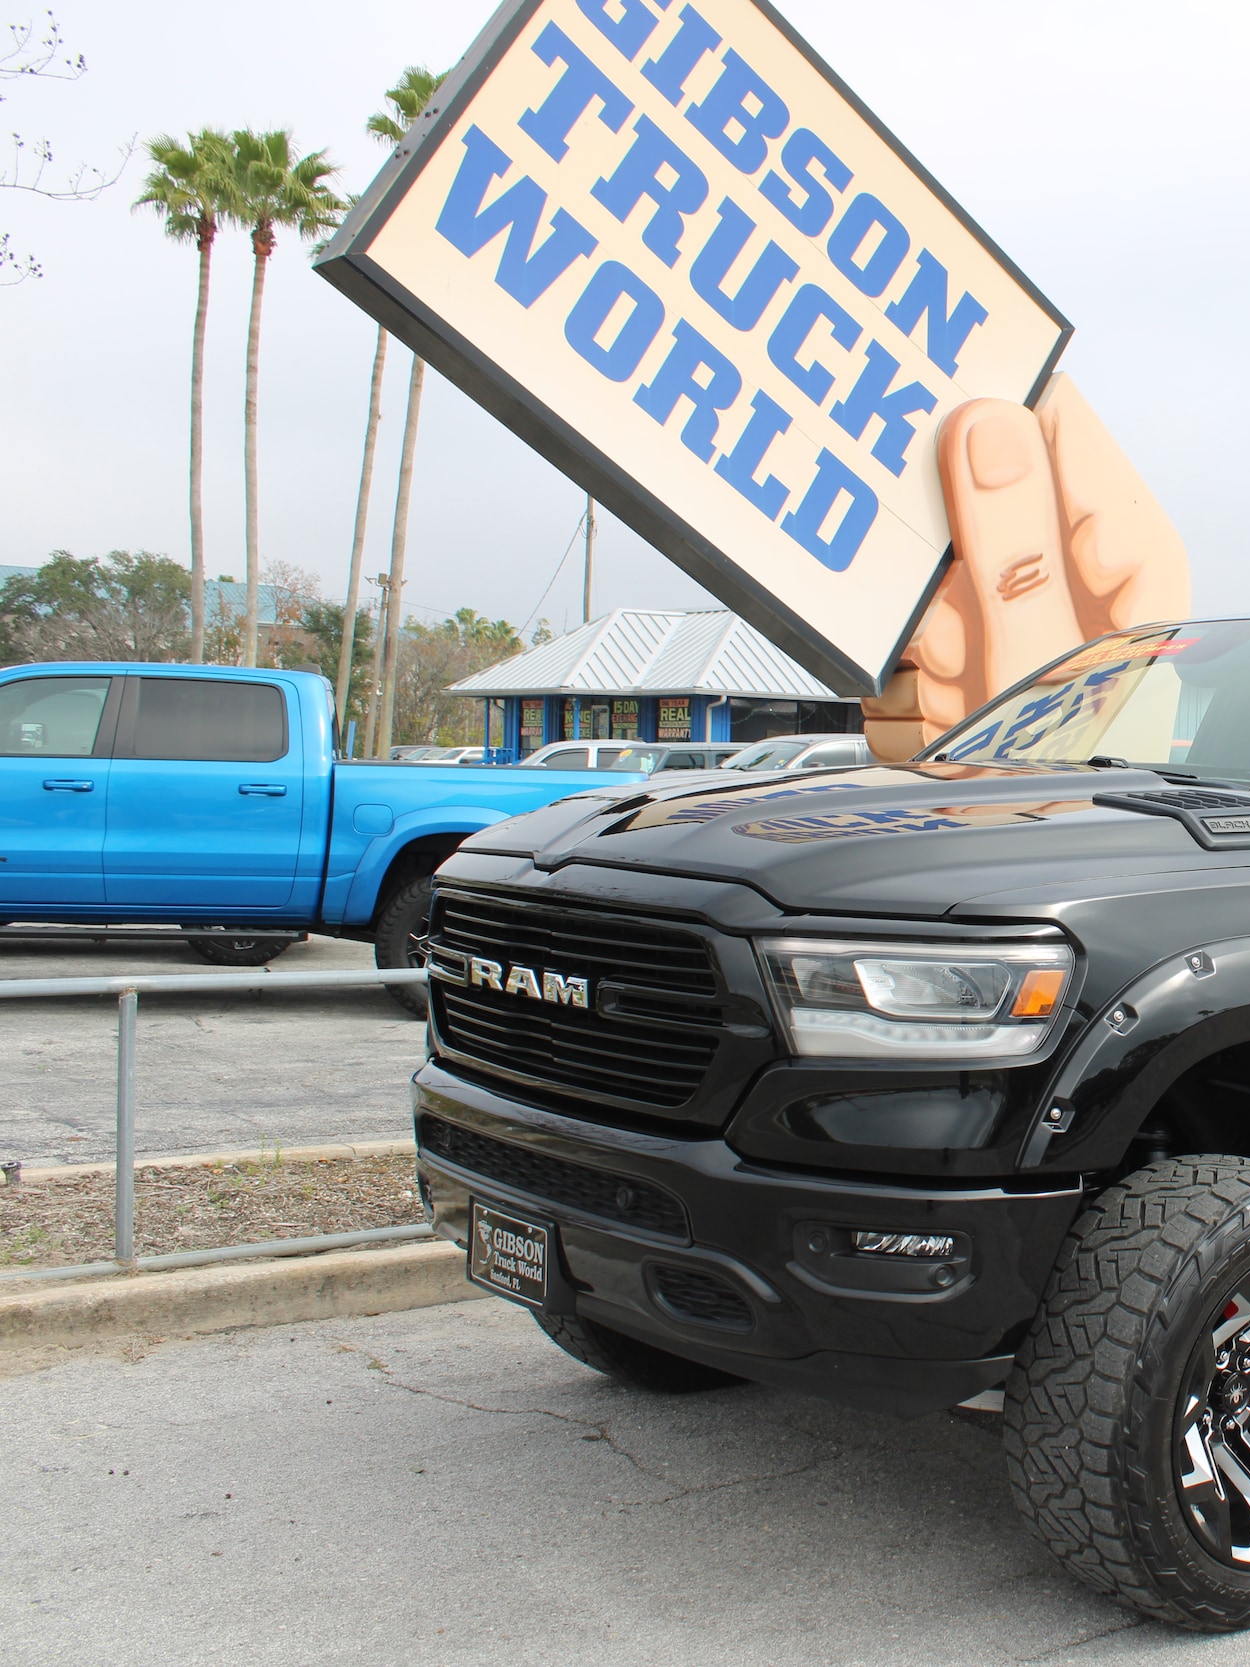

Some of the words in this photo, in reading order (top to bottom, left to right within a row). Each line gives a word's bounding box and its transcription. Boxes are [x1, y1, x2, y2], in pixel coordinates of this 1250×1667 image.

[575, 0, 988, 378] GIBSON
[517, 20, 938, 478] TRUCK
[434, 124, 879, 573] WORLD
[523, 709, 543, 720] REA
[614, 701, 623, 713] 15
[624, 701, 639, 713] DAY
[660, 707, 691, 721] REAL
[1208, 820, 1250, 829] BLACK
[469, 955, 589, 1009] RAM
[493, 1227, 544, 1265] GIBSON
[493, 1251, 516, 1272] Truck
[517, 1260, 542, 1282] World
[512, 1278, 520, 1290] FL
